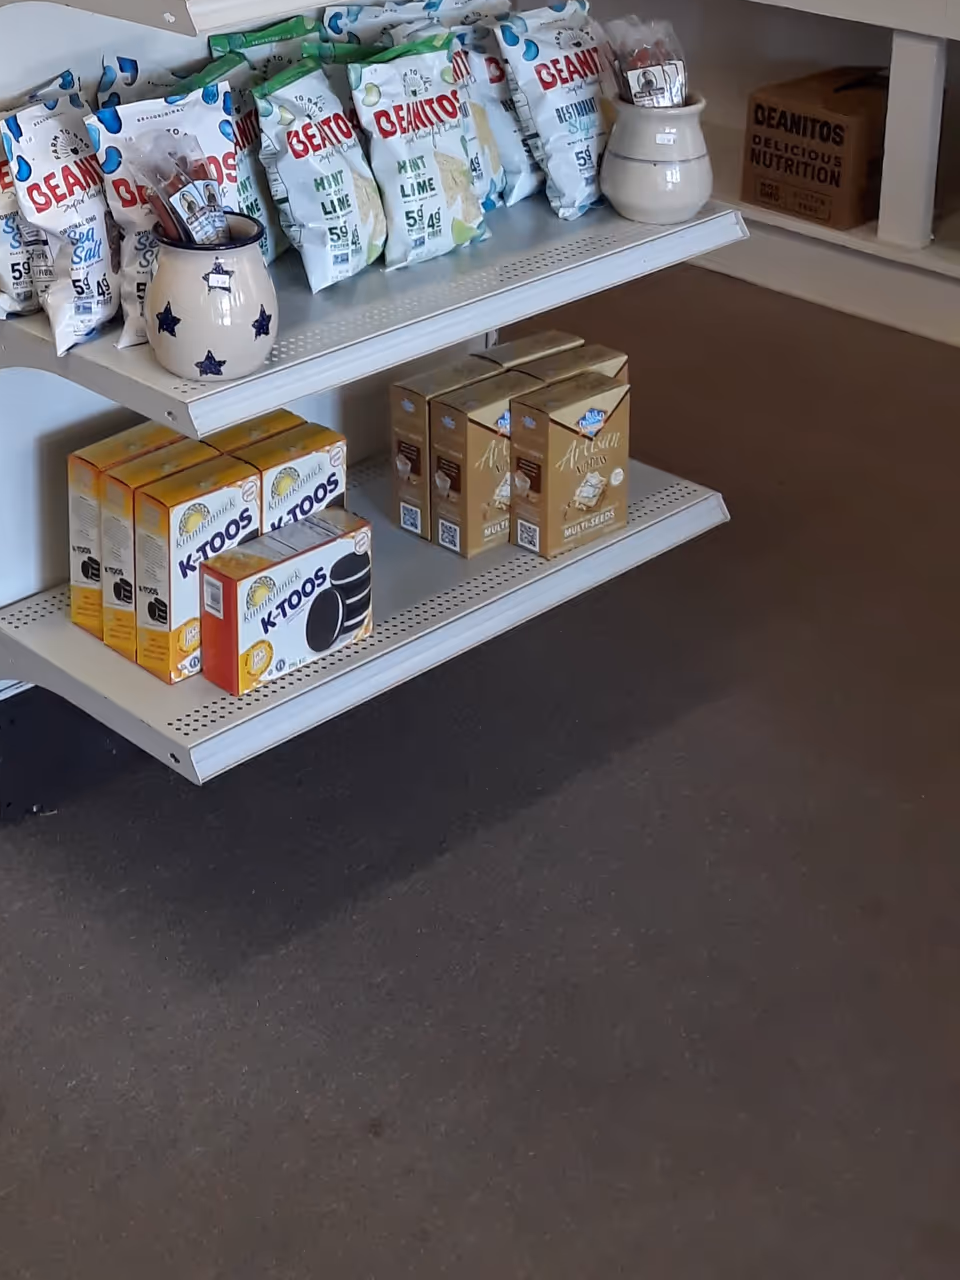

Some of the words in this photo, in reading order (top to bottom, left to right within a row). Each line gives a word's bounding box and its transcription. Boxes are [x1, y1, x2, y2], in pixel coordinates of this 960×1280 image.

[754, 102, 844, 147] BEANITOS
[51, 135, 61, 160] FARM
[752, 134, 842, 167] DELICIOUS
[397, 155, 427, 175] HINT
[751, 148, 841, 188] NUTRITION
[400, 177, 436, 199] LIME
[405, 204, 424, 228] 5g
[427, 206, 442, 229] 4g
[67, 226, 95, 246] Sea
[328, 221, 349, 243] 5g
[71, 238, 102, 265] Salt
[11, 261, 31, 281] 5g
[72, 273, 91, 296] 5g
[96, 272, 112, 298] 4g
[555, 432, 620, 472] Artisan
[268, 463, 324, 512] kinnikinnick
[270, 471, 340, 533] K-TOOS
[175, 496, 237, 550] kinnikinnick
[564, 509, 615, 538] MULTI-SEEDS
[178, 506, 254, 580] K-TOOS
[243, 569, 302, 624] kinnikinnick
[259, 566, 328, 635] K-TOOS
